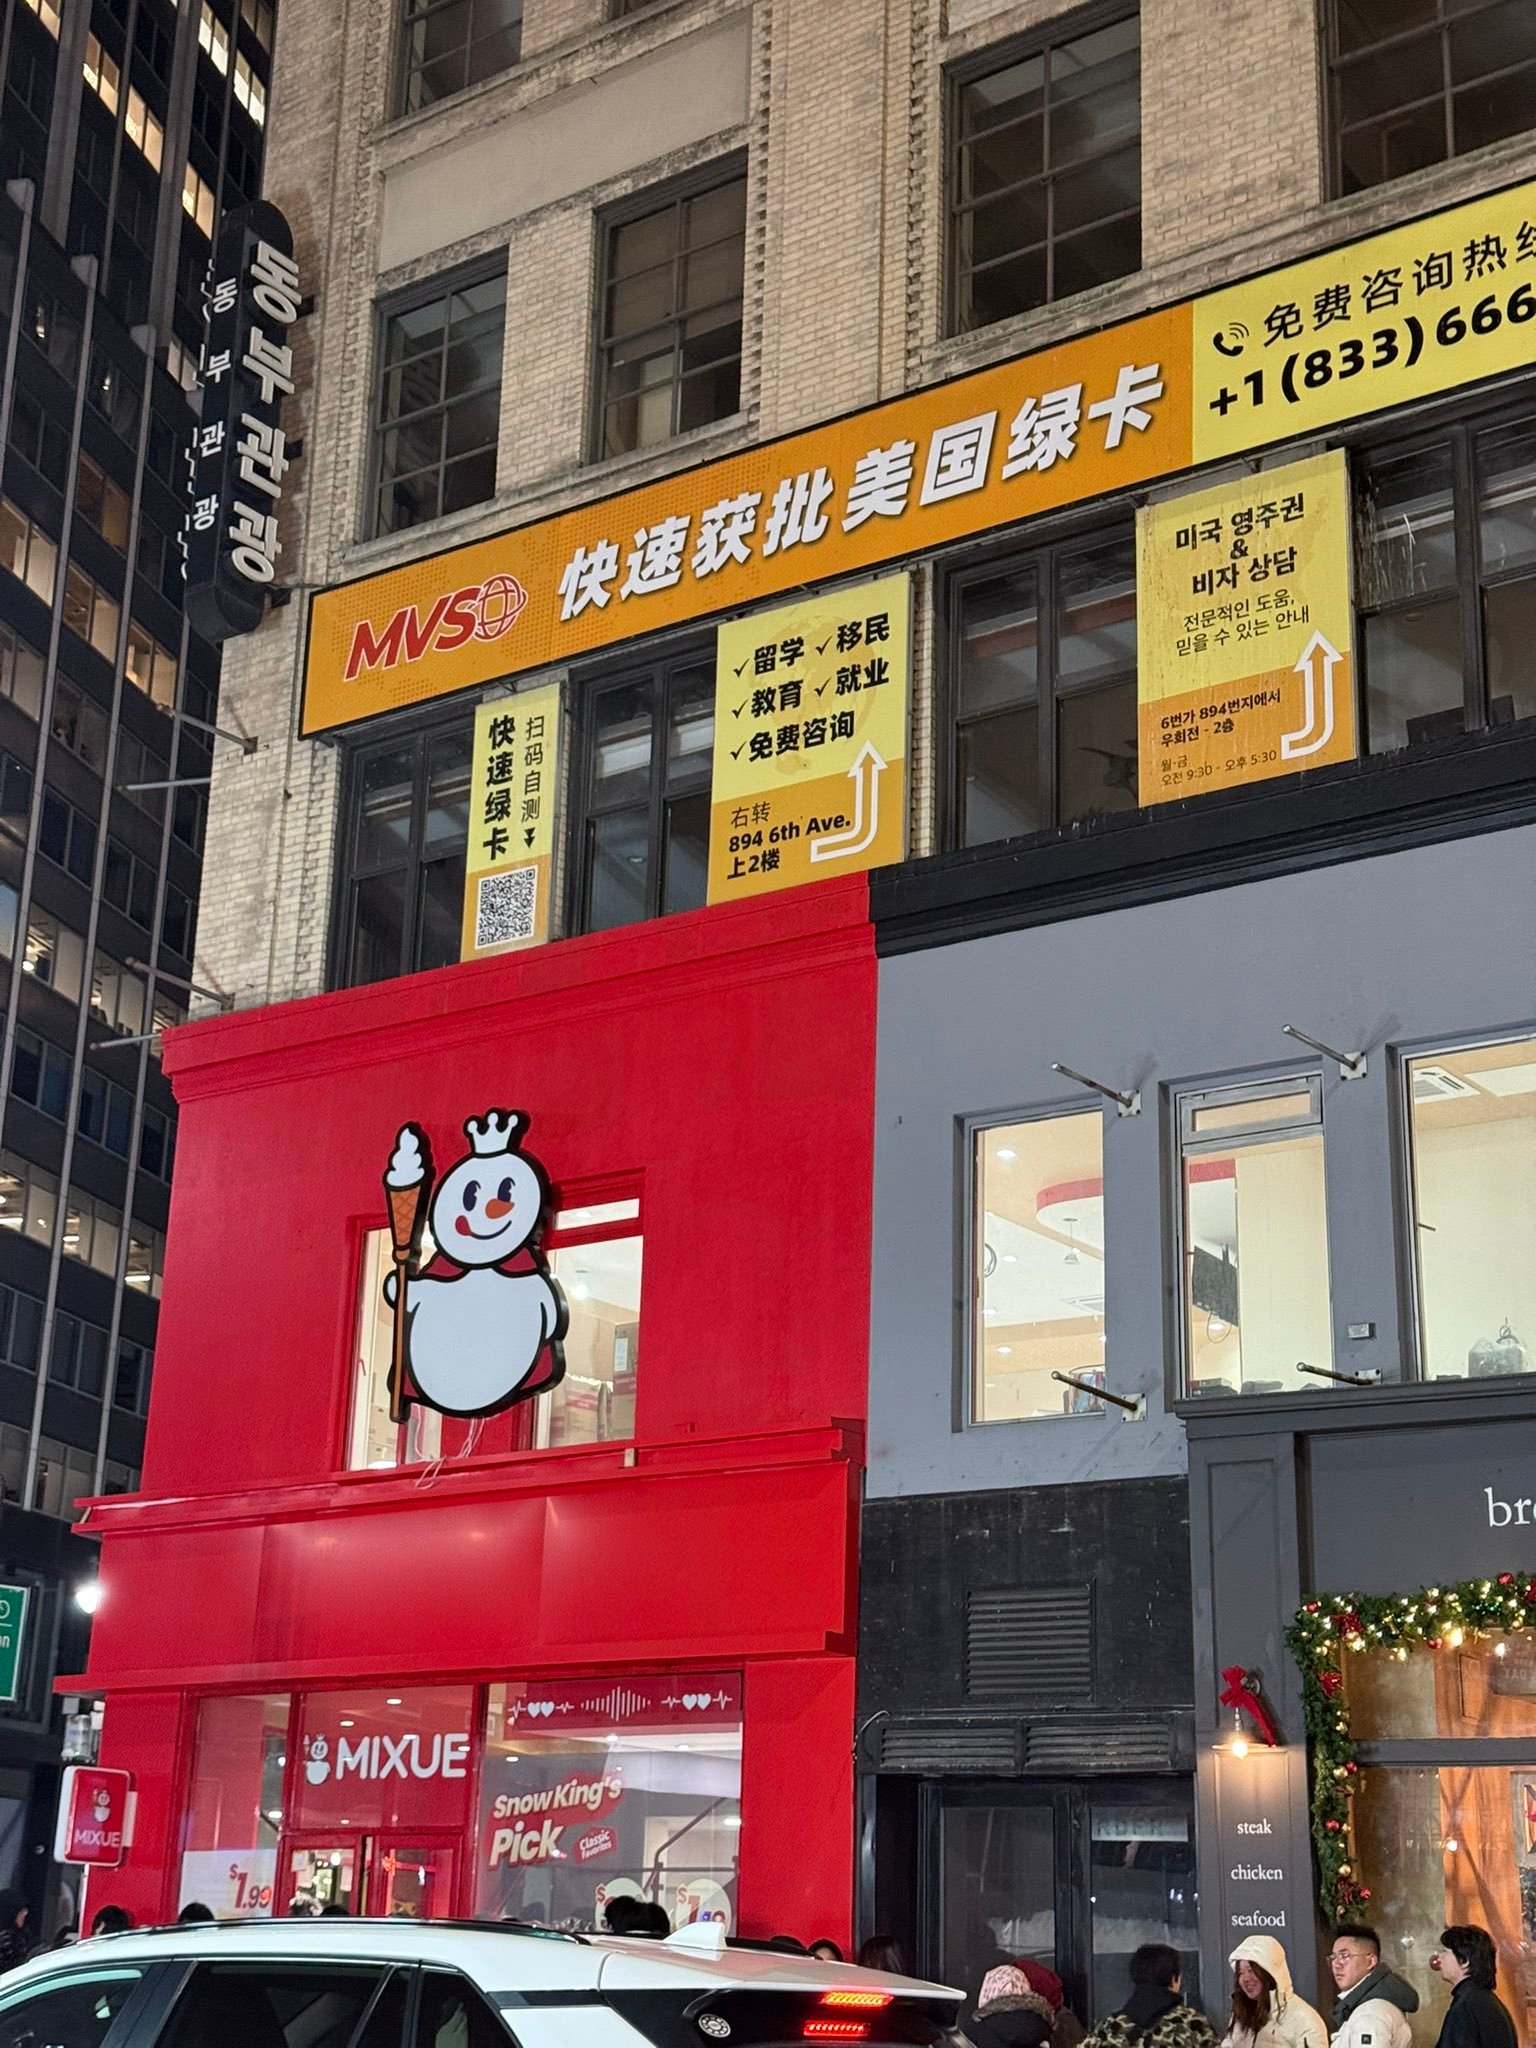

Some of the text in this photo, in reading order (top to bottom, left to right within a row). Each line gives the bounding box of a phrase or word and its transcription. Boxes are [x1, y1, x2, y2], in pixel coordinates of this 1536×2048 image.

[193, 277, 237, 531] 동부관광
[229, 240, 302, 584] 동부관광
[557, 363, 1164, 622] 快速获批美国绿卡
[1176, 492, 1304, 550] 미국 영주권
[1230, 538, 1249, 560] &
[1192, 546, 1297, 595] 비자 상담
[836, 612, 890, 653] 移民
[1176, 605, 1309, 656] 믿을 수 있는 안내
[1184, 599, 1249, 632] 전문적인
[753, 636, 805, 676] 留学
[835, 657, 890, 696] 就业
[751, 679, 804, 718] 教育
[749, 710, 855, 762] 免费咨询
[1160, 711, 1196, 730] 6번가
[1161, 725, 1200, 748] 우회전
[521, 715, 545, 823] 扫码自测
[1250, 750, 1277, 765] 5:30
[483, 714, 516, 861] 快速绿卡
[728, 814, 851, 852] 894 6th Ave.
[731, 801, 771, 829] 右转
[727, 848, 780, 880] 上2楼
[1484, 1487, 1536, 1527] br
[335, 1733, 469, 1779] MIXUE
[74, 1831, 122, 1847] MIXUE
[488, 1819, 565, 1867] Pick
[1237, 1818, 1272, 1834] steak
[1231, 1864, 1283, 1880] chicken
[1231, 1910, 1286, 1927] seafood
